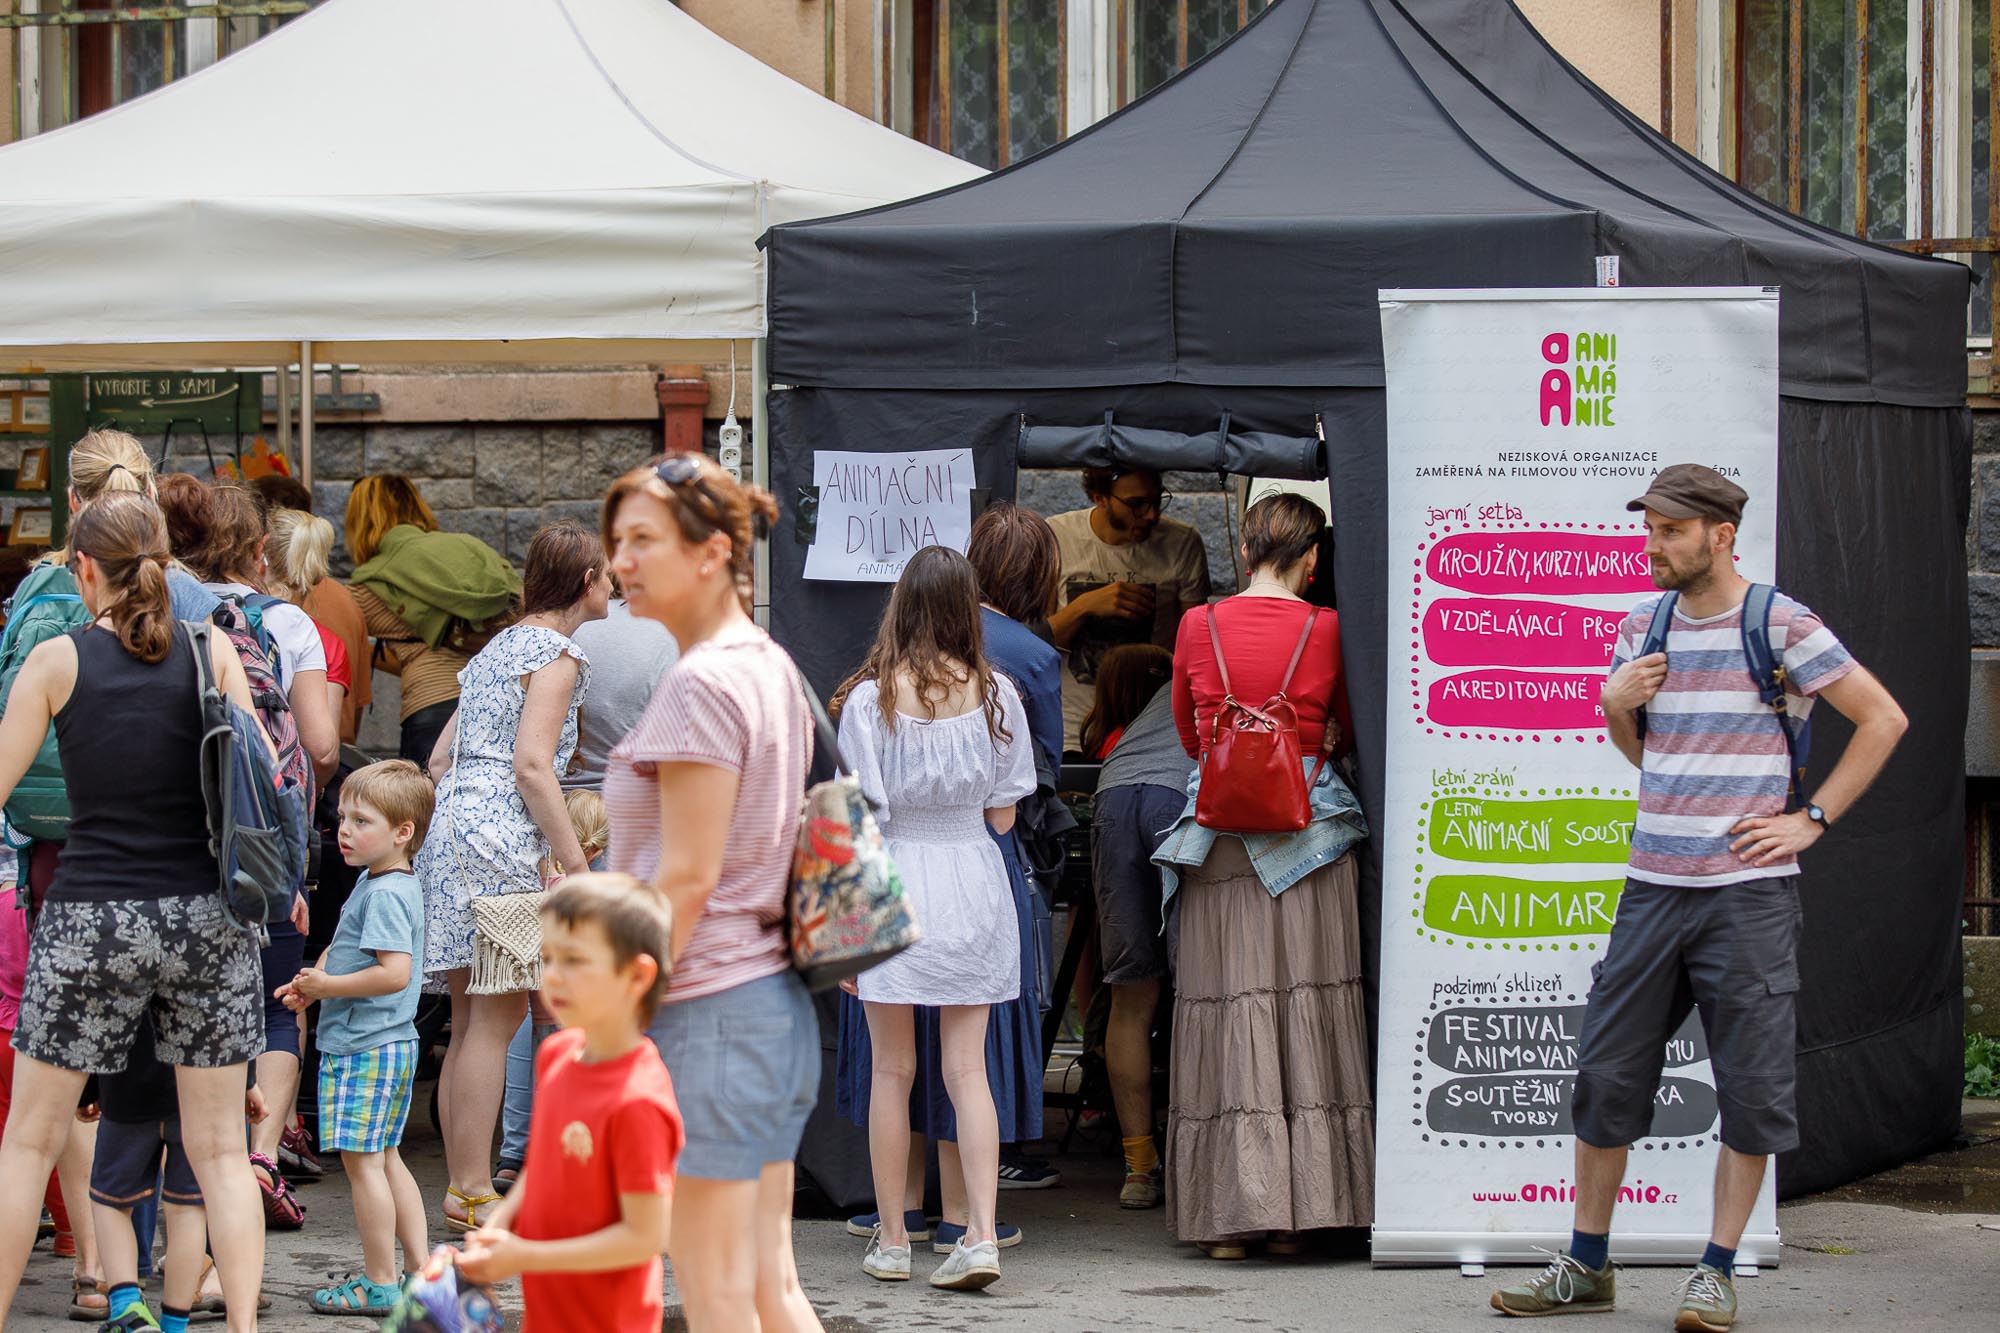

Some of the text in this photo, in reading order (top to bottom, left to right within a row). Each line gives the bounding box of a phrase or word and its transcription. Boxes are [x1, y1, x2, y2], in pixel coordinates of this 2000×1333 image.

[95, 378, 217, 396] VYROBTE SI SAMI
[1498, 450, 1658, 462] NEZISKOVÁ ORGANIZACE
[822, 453, 964, 506] ANIMAČNÍ
[1415, 464, 1483, 477] ZAMĚŘENÁ
[1488, 467, 1506, 477] NA
[1511, 467, 1577, 477] FILMOVOU
[1582, 464, 1646, 477] VÝCHOVU
[1650, 467, 1659, 477] A
[1424, 501, 1523, 527] jarní setba
[846, 510, 939, 555] DÍLNA
[856, 559, 905, 575] ANIMÁ
[1584, 550, 1653, 578] WORKS
[1439, 608, 1568, 639] VZDĚLÁVACÍ
[1442, 676, 1589, 702] AKREDITOVANÉ
[1473, 765, 1518, 788] zrání
[1443, 800, 1486, 817] LETNÍ
[1564, 819, 1635, 847] SOUST
[1432, 971, 1562, 1001] podzimní sklizeň
[1443, 1013, 1577, 1045] FESTIVAL
[1454, 1039, 1695, 1070] ANIMOVAN MU
[1445, 1079, 1564, 1107] SOUTĚŽNÍ
[1490, 1110, 1559, 1127] TVORBY
